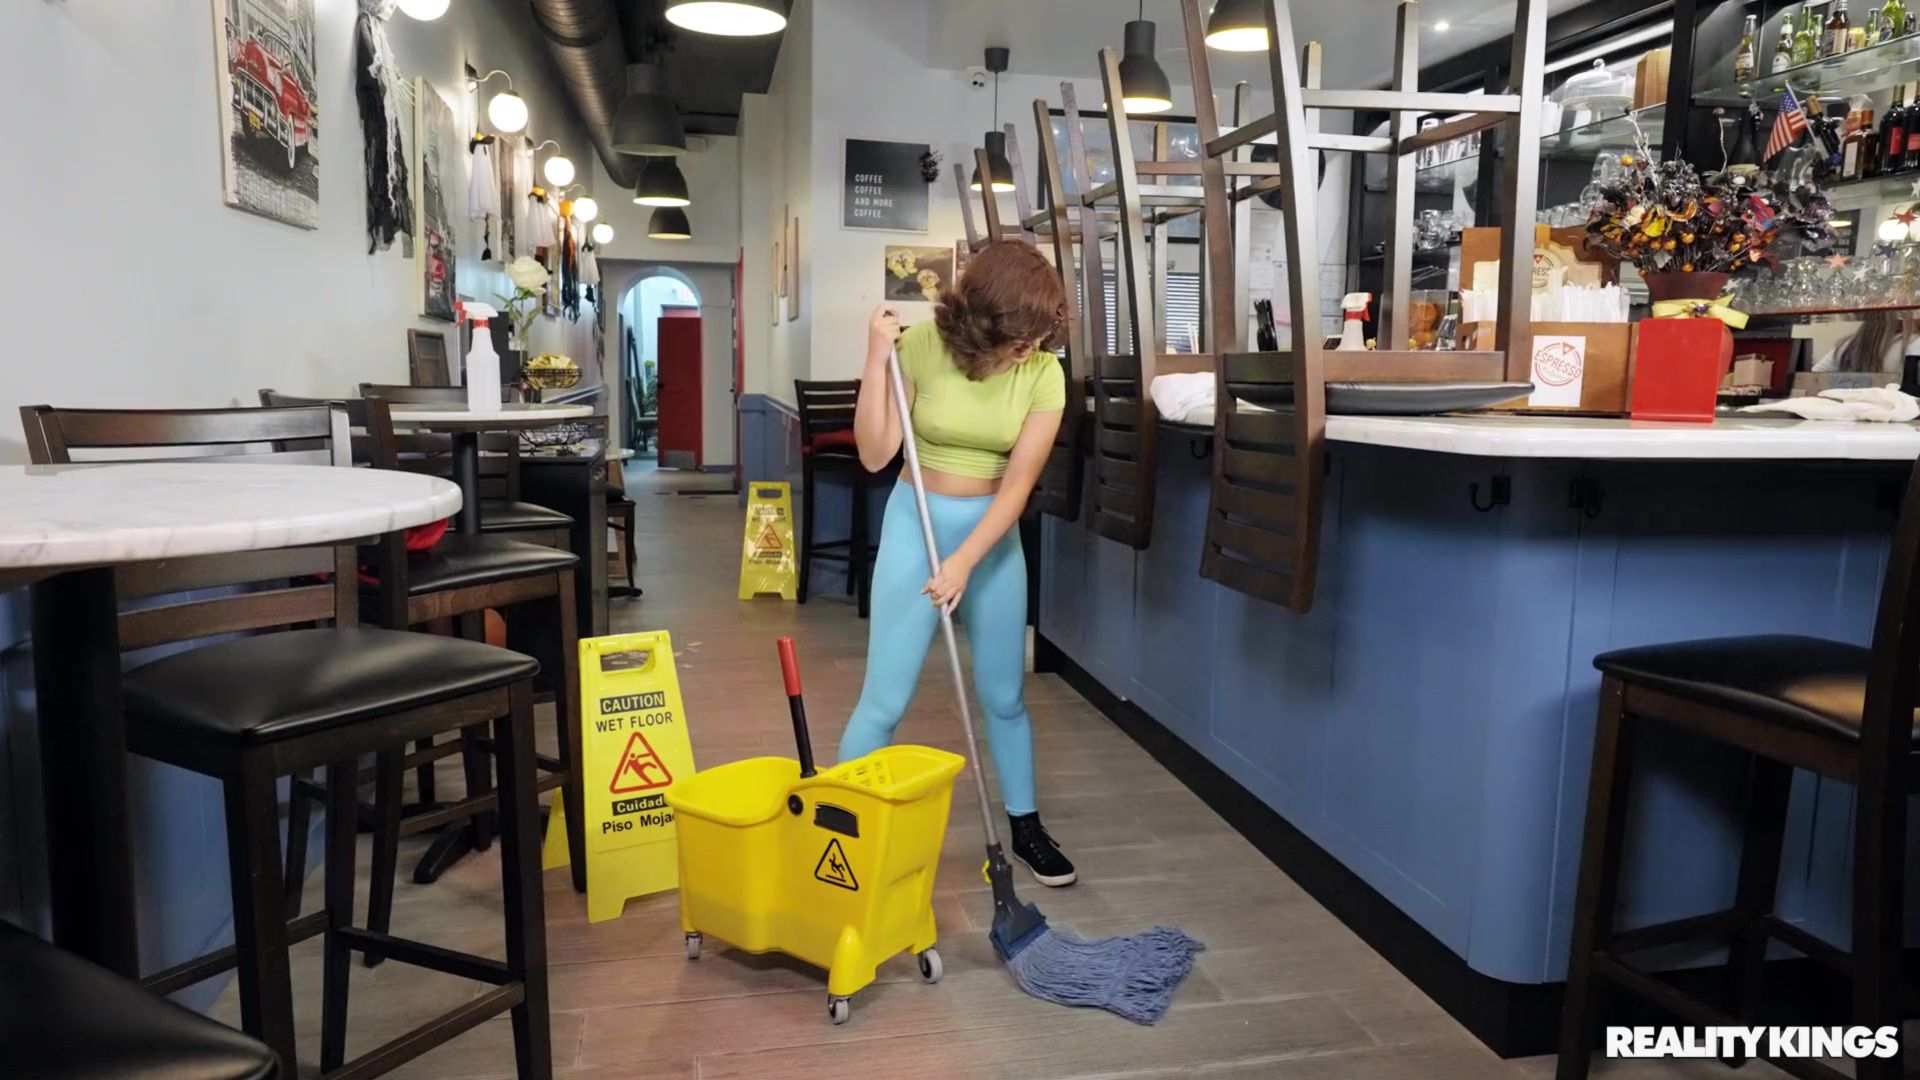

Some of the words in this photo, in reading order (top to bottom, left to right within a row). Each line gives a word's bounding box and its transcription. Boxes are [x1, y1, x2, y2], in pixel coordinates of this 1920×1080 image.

[855, 174, 882, 183] COFFEE
[854, 185, 882, 195] COFFEE
[854, 197, 871, 206] AND
[873, 198, 893, 207] MORE
[854, 209, 881, 217] COFFEE
[1535, 350, 1582, 379] ESPRESSO
[602, 693, 664, 713] CAUTION
[596, 717, 623, 733] WET
[630, 711, 673, 728] FLOOR
[616, 795, 664, 813] Cuidad
[602, 821, 633, 834] Piso
[640, 812, 675, 827] Moja
